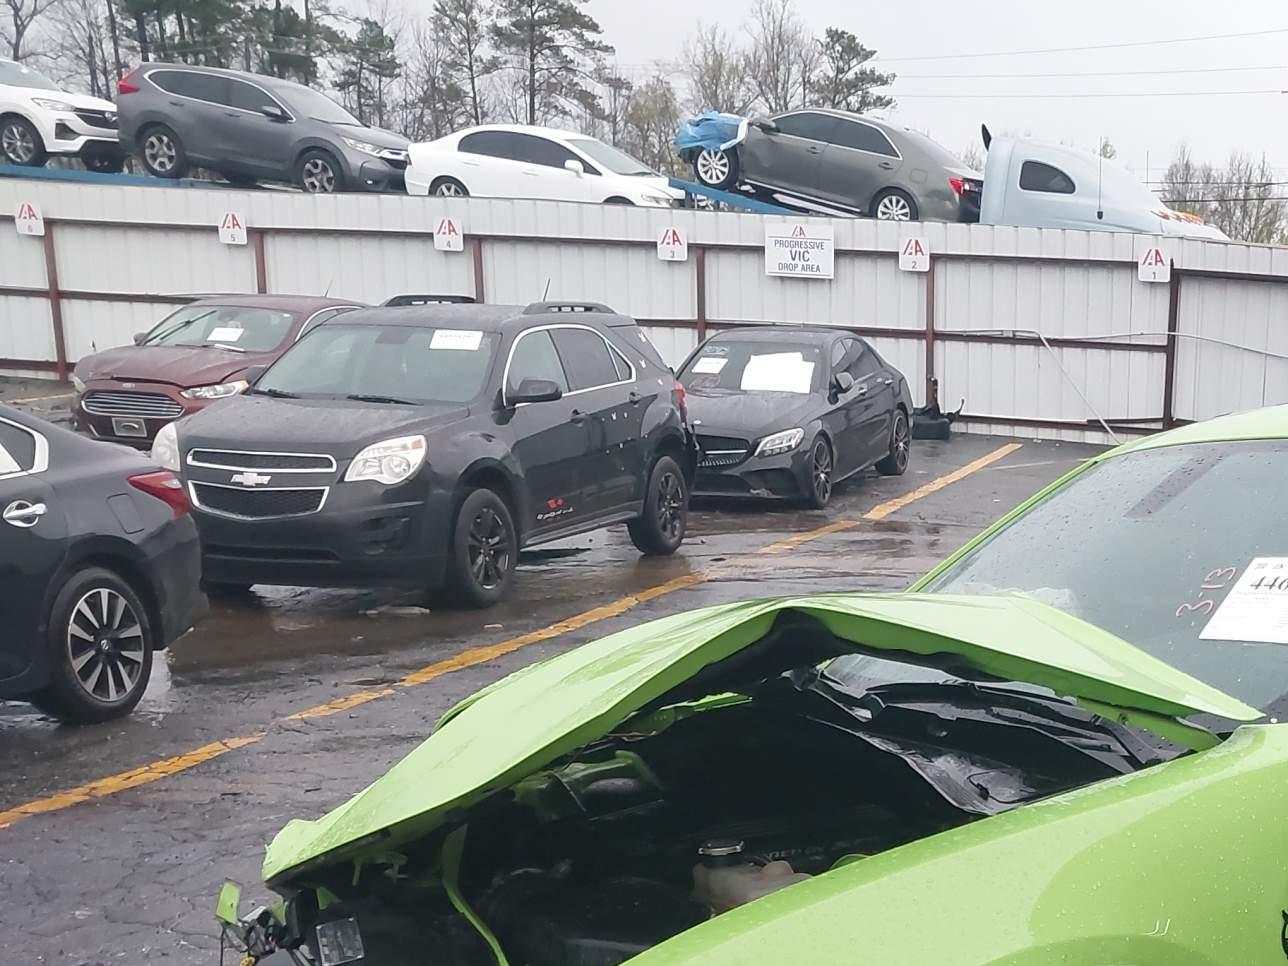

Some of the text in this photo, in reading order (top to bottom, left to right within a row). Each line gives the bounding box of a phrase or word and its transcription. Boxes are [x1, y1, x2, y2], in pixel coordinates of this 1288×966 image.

[774, 239, 825, 250] PROGRESSIVE
[789, 250, 810, 262] VIC
[778, 262, 821, 273] DROP AREA
